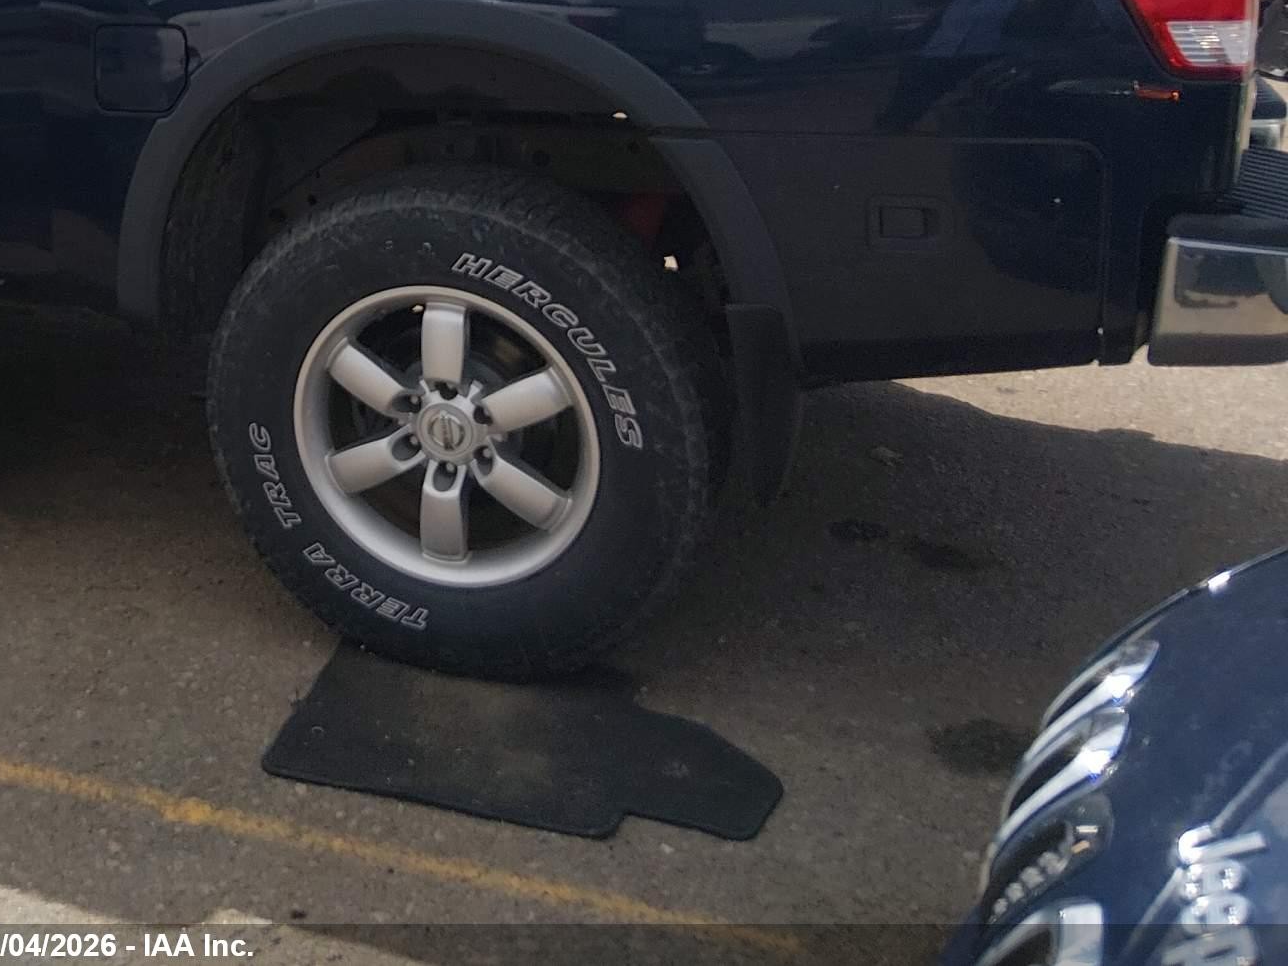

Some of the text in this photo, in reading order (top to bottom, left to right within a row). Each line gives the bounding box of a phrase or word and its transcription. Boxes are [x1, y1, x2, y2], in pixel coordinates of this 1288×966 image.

[452, 251, 643, 451] HERCULES
[249, 423, 430, 631] TERRA TRAC
